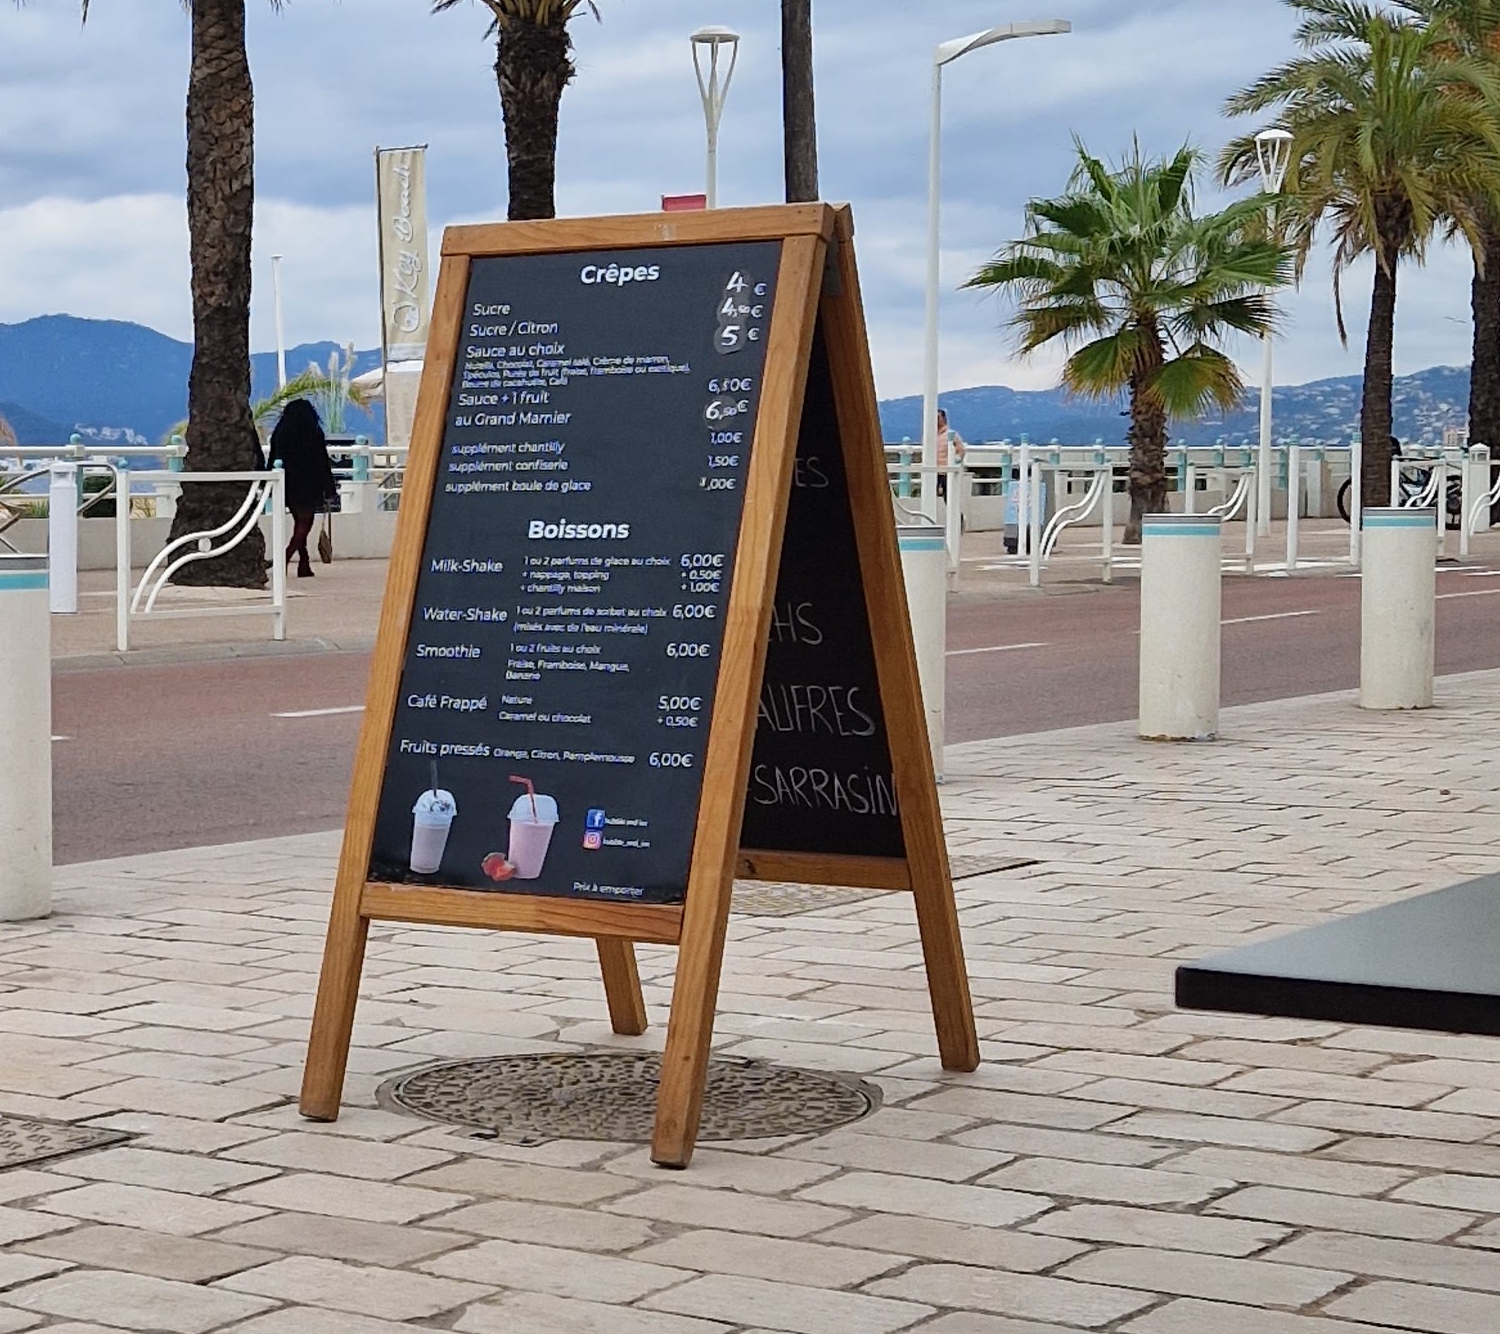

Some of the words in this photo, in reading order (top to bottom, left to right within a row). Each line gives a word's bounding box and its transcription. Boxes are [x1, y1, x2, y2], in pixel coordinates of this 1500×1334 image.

[580, 263, 661, 287] Crêpes
[726, 271, 748, 293] 4
[472, 303, 511, 316] Sucre
[469, 324, 507, 337] Sucre
[517, 321, 558, 335] Citron
[721, 325, 740, 346] 5
[466, 345, 506, 359] Sauce
[509, 345, 526, 357] au
[528, 341, 566, 357] choix
[457, 393, 499, 406] Sauce
[501, 393, 510, 404] +
[519, 390, 551, 405] fruit
[454, 415, 472, 427] au
[474, 412, 516, 426] Grand
[518, 410, 572, 425] Marnier
[451, 443, 517, 456] supplément
[517, 441, 565, 455] chantilly
[448, 460, 513, 475] supplément
[515, 458, 569, 471] confiserie
[444, 479, 509, 494] supplément
[511, 478, 543, 491] boule
[544, 479, 559, 491] de
[560, 479, 592, 494] glace
[528, 518, 630, 539] Boissons
[430, 558, 503, 573] Milk-Shake
[529, 557, 542, 566] ou
[542, 556, 550, 566] 2
[550, 556, 589, 567] parfums
[590, 557, 603, 566] de
[604, 556, 630, 567] glace
[631, 557, 643, 566] au
[645, 556, 671, 566] choix
[680, 554, 725, 569] 6,00€
[423, 606, 508, 622] Water-Shake
[521, 608, 534, 616] ou
[534, 606, 541, 615] 2
[542, 605, 581, 617] parfums
[582, 607, 595, 616] de
[627, 608, 640, 617] au
[672, 604, 717, 620] 6,00€
[416, 643, 482, 658] Smoothie
[515, 645, 528, 653] ou
[528, 643, 535, 653] 2
[536, 643, 561, 653] fruits
[561, 645, 575, 653] au
[666, 642, 711, 658] 6,00€
[407, 693, 437, 708] Café
[440, 695, 488, 712] Frappé
[501, 694, 533, 705] Nature
[658, 695, 702, 711] 5,00€
[498, 711, 537, 721] Caramel
[537, 713, 550, 723] ou
[399, 739, 437, 754] Fruits
[440, 741, 490, 757] pressés
[649, 752, 693, 768] 6,00€
